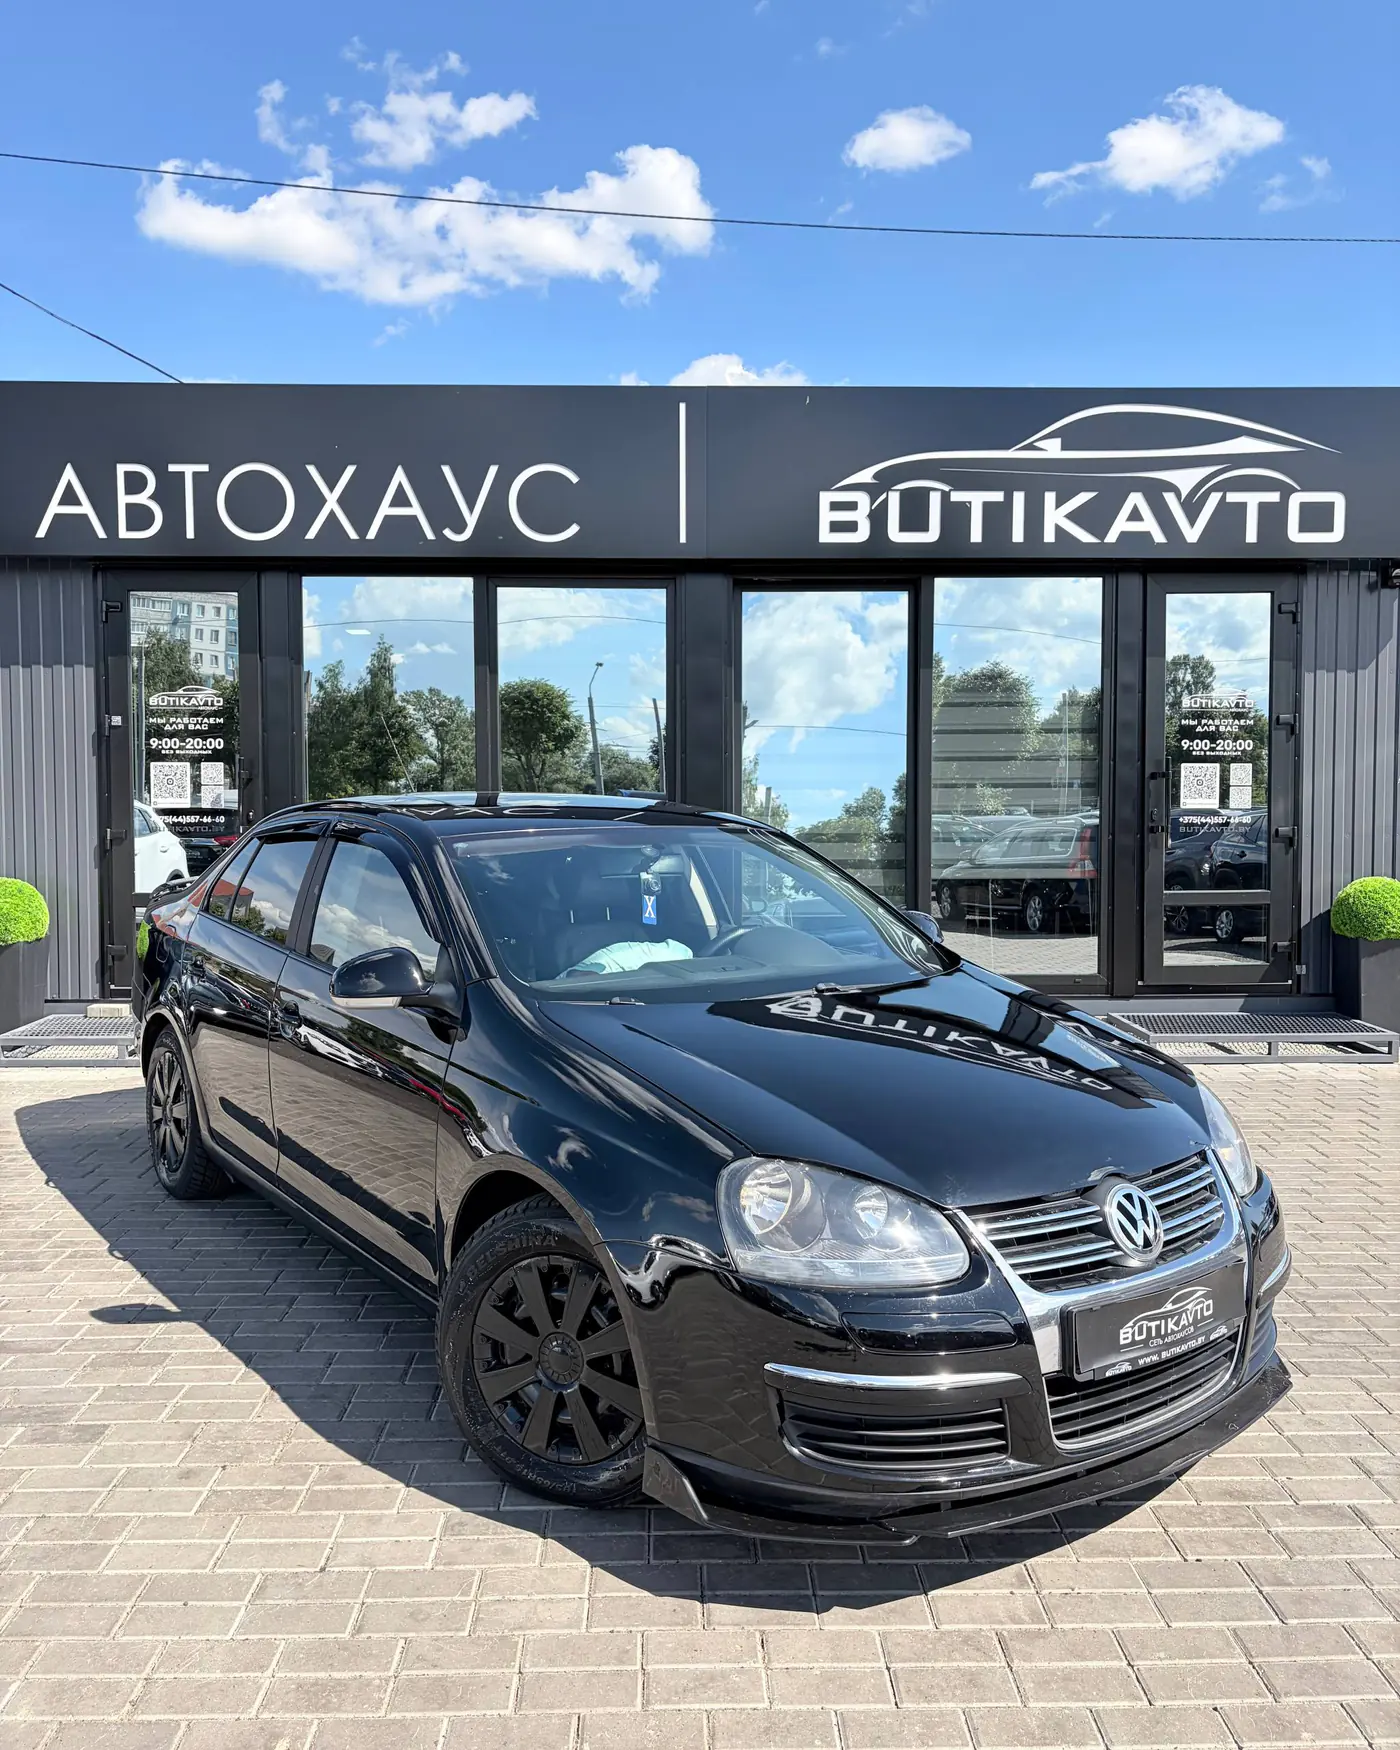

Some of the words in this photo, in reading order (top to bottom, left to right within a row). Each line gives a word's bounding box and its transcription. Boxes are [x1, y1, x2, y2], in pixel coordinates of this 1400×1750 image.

[35, 462, 582, 542] АВТОХАУС
[819, 490, 1346, 544] BUTIKAVTO
[149, 696, 224, 706] BUTIKAVTO
[149, 737, 224, 749] 9:00-20:00
[1181, 739, 1254, 751] 9:00-20:00
[156, 815, 225, 824] 75(44)557-66-60
[1178, 815, 1252, 824] +375(44)557-66-60
[1107, 1185, 1162, 1257] VW
[1120, 1298, 1213, 1345] BUTIKAVTO
[1149, 1337, 1163, 1347] СЕТЬ
